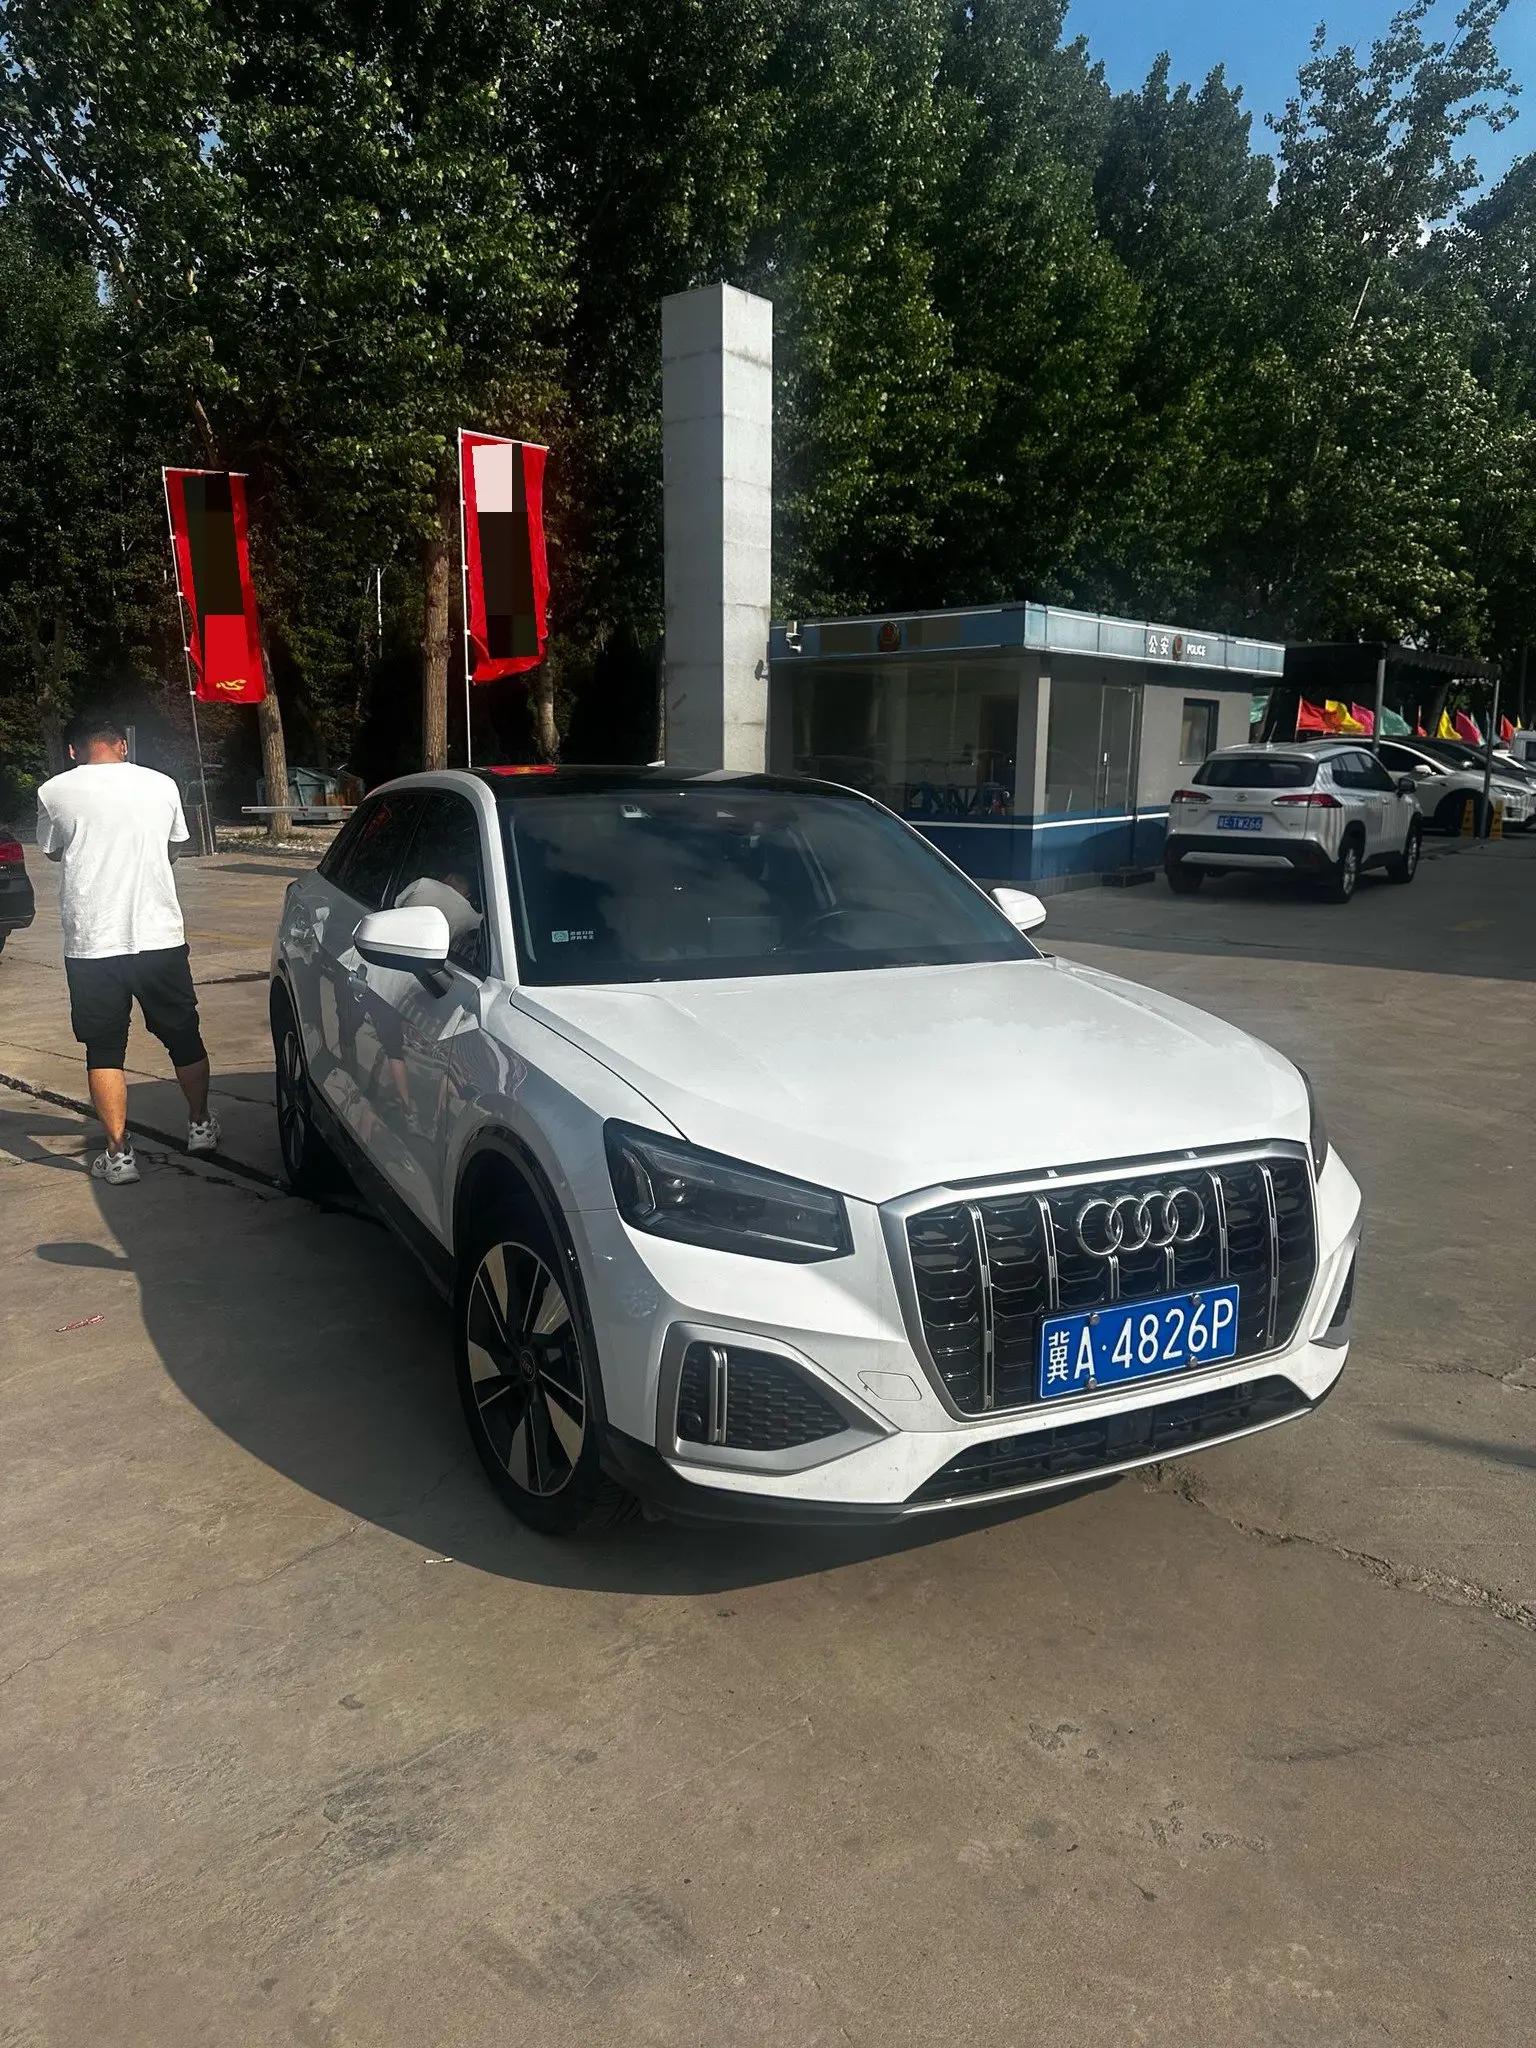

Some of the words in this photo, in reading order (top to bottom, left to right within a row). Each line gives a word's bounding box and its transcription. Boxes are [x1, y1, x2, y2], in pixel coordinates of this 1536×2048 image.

[1148, 635, 1170, 655] 公安
[1186, 643, 1206, 656] POLICE
[1047, 1299, 1234, 1385] 冀A·4826P
